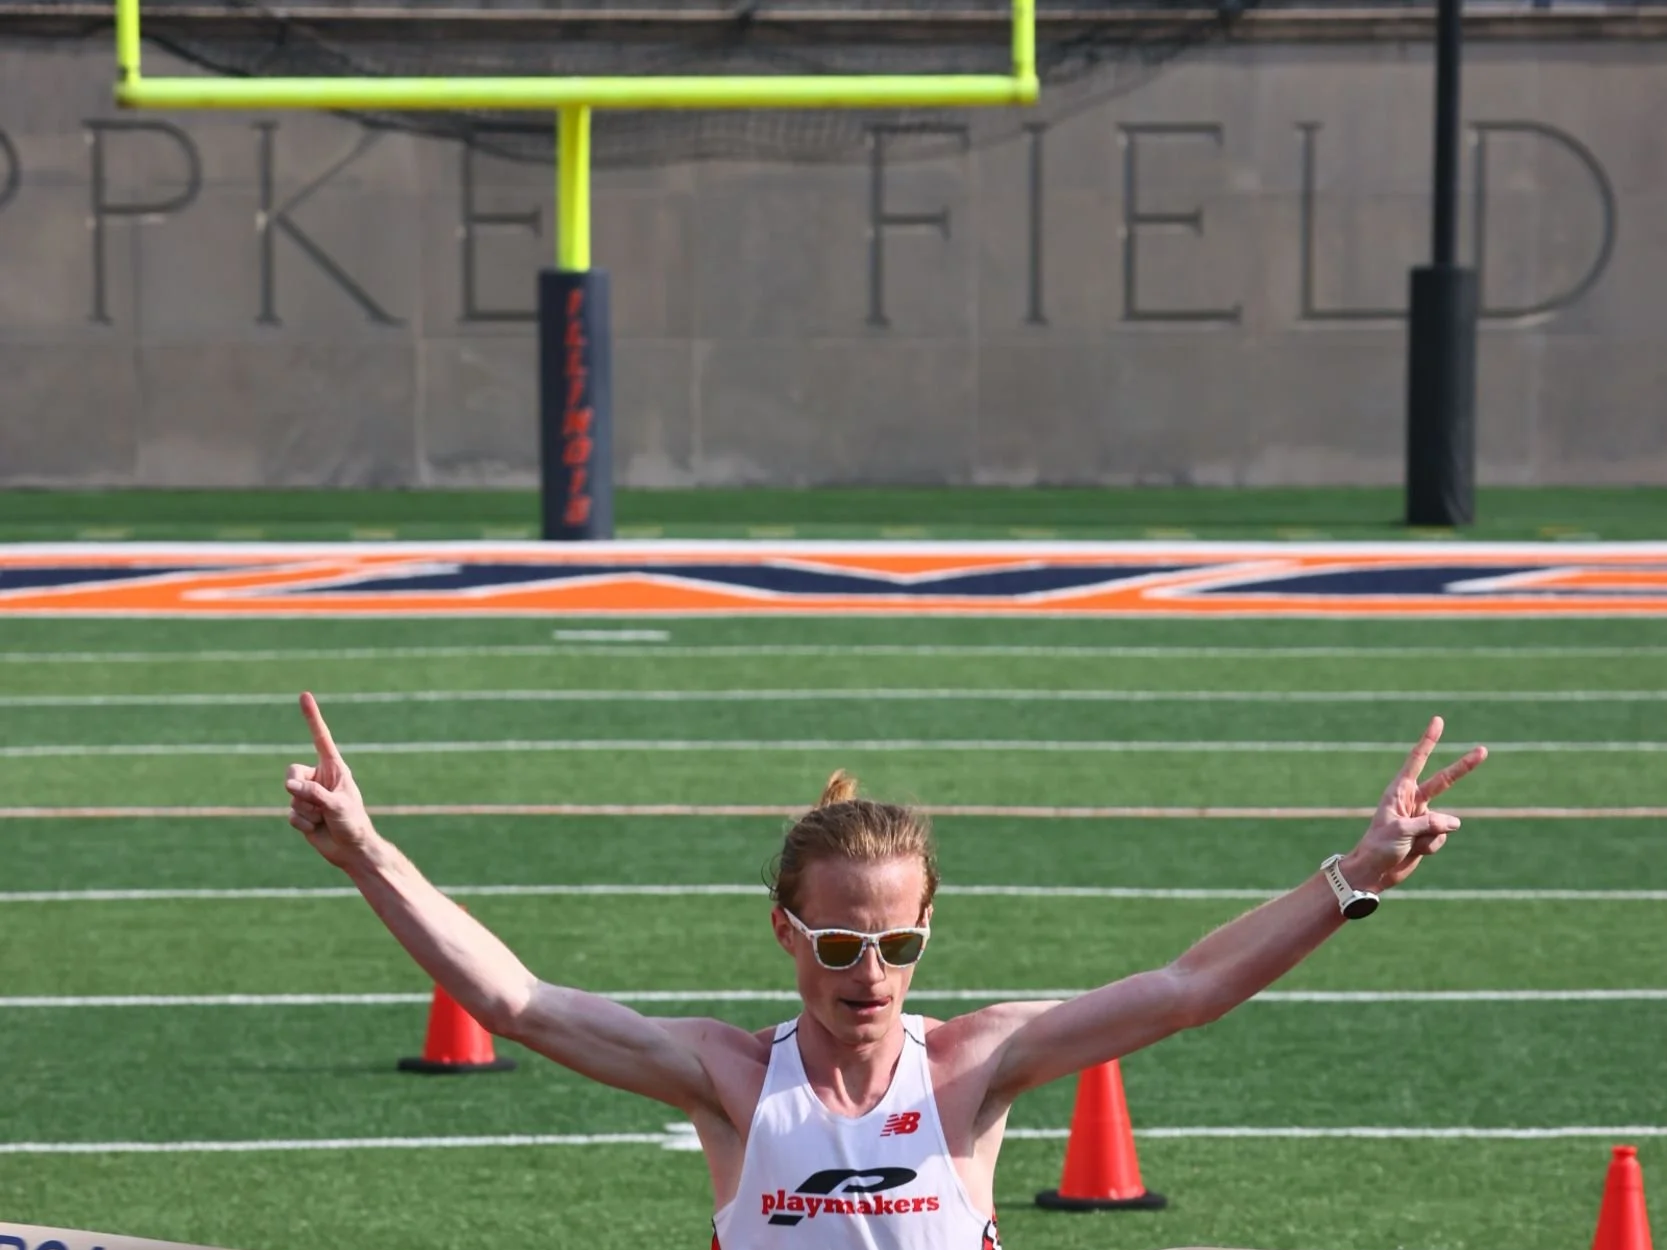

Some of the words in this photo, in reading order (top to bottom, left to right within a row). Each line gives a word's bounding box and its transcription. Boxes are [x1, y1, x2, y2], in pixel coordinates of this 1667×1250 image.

[863, 120, 1617, 327] FIELD
[563, 289, 593, 526] ILLINOIS
[762, 1190, 939, 1218] playmakers
